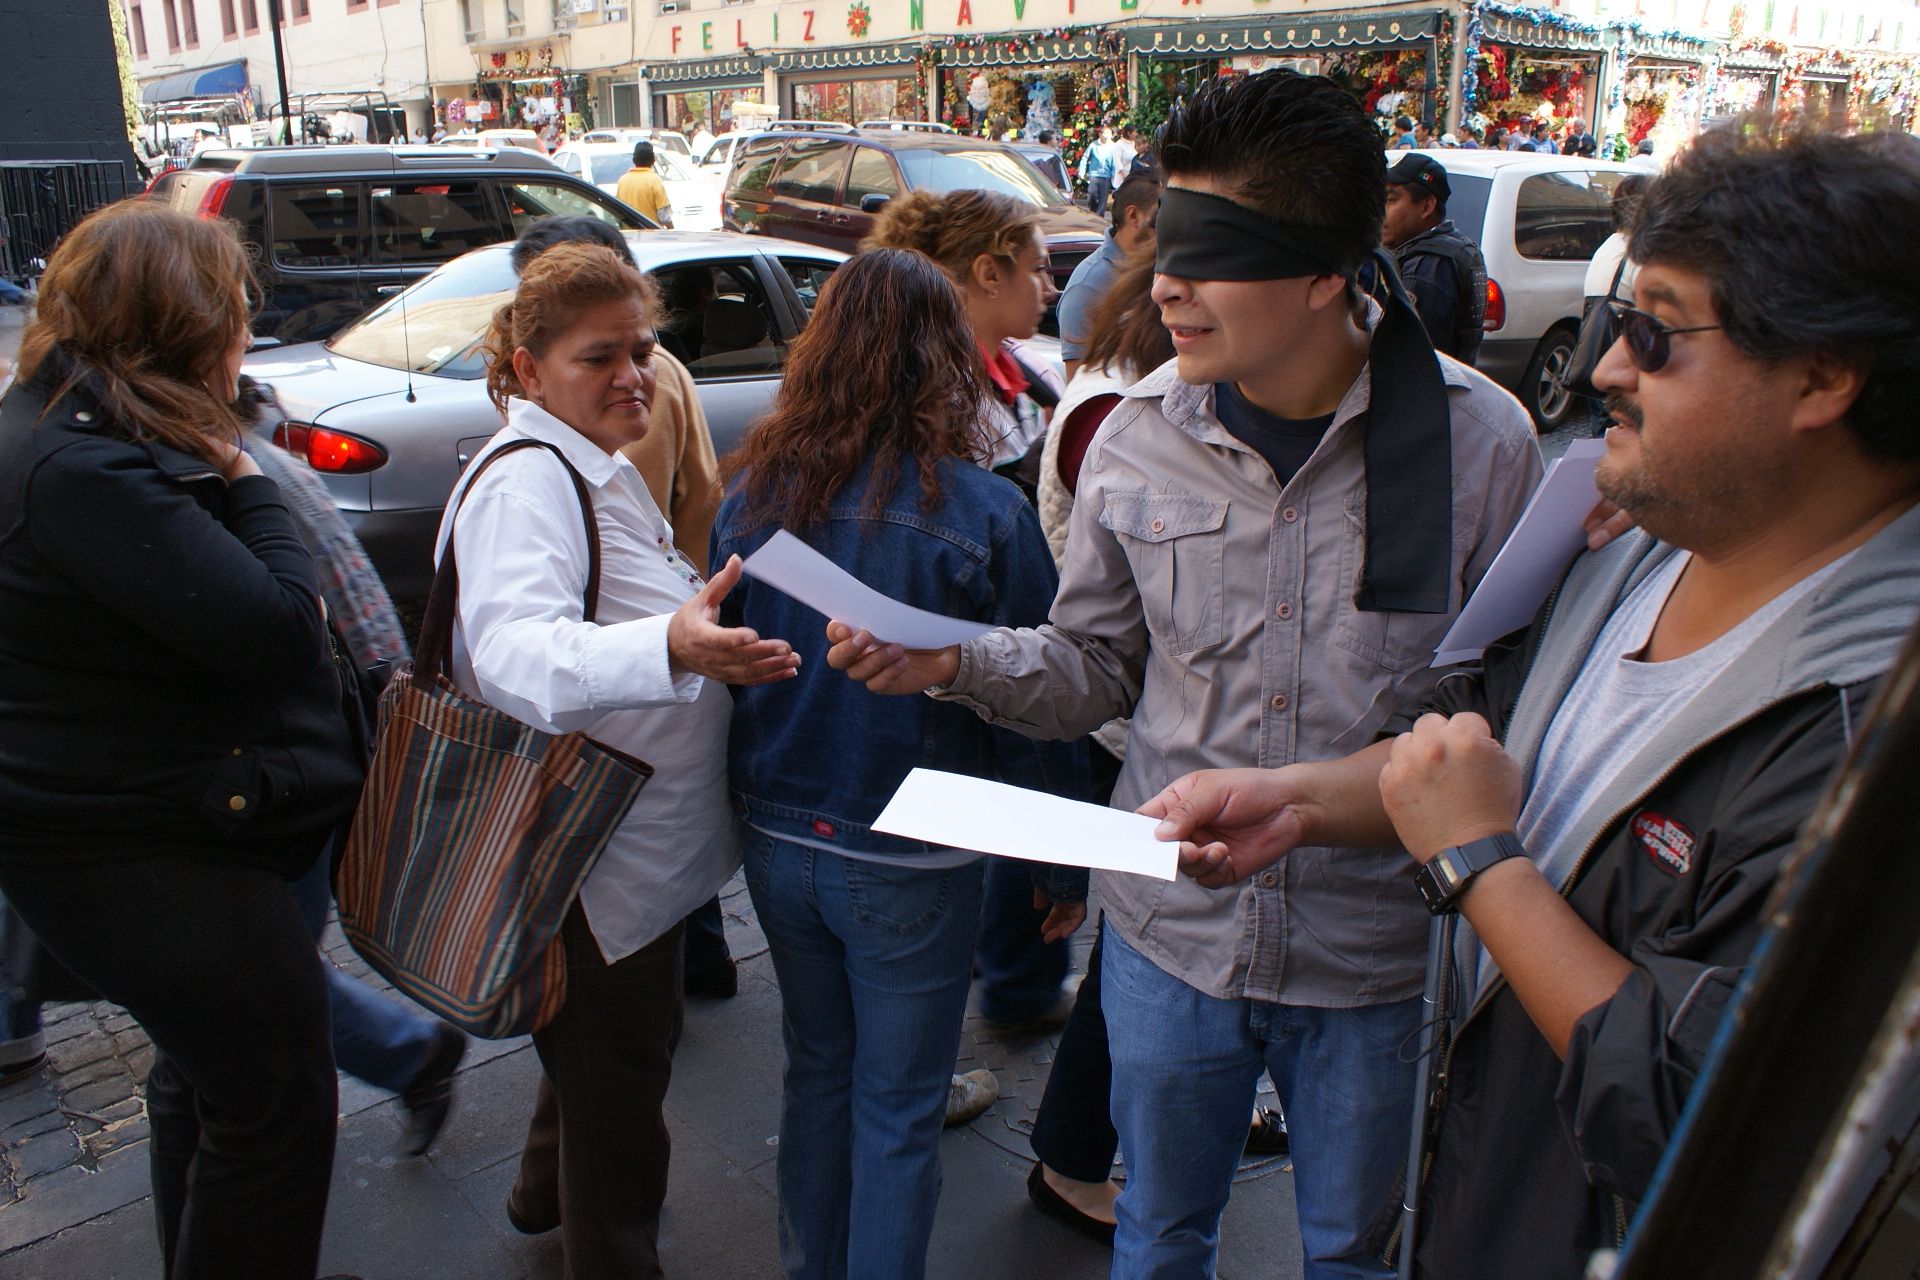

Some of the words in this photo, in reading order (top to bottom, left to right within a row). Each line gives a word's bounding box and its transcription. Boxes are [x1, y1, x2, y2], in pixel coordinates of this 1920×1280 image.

[671, 10, 815, 54] FELIZ
[911, 0, 1269, 30] NAVI
[1154, 22, 1401, 46] Floricentro
[779, 47, 901, 66] Floricentro
[653, 61, 749, 78] Floricentro
